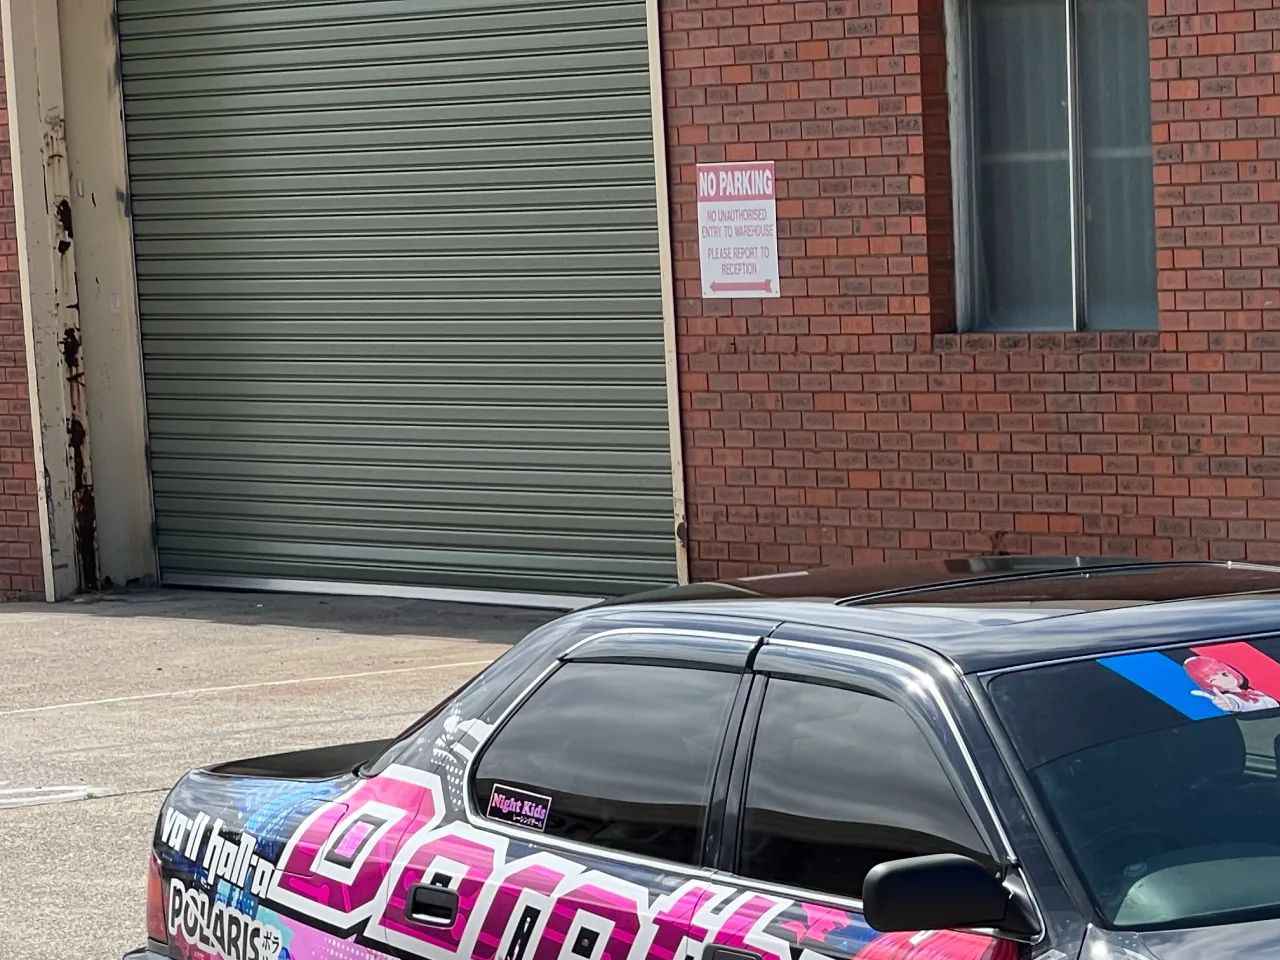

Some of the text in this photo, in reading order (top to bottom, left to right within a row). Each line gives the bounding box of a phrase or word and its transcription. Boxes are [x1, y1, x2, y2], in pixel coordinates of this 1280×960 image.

[700, 169, 773, 196] NO PARKING
[707, 208, 766, 222] NO UNAUTHORISED
[702, 223, 774, 238] ENTRY TO WAREHOUSE
[707, 246, 769, 260] PLEASE REPORT TO
[721, 262, 757, 275] RECEPTION
[492, 793, 546, 820] Night Kids
